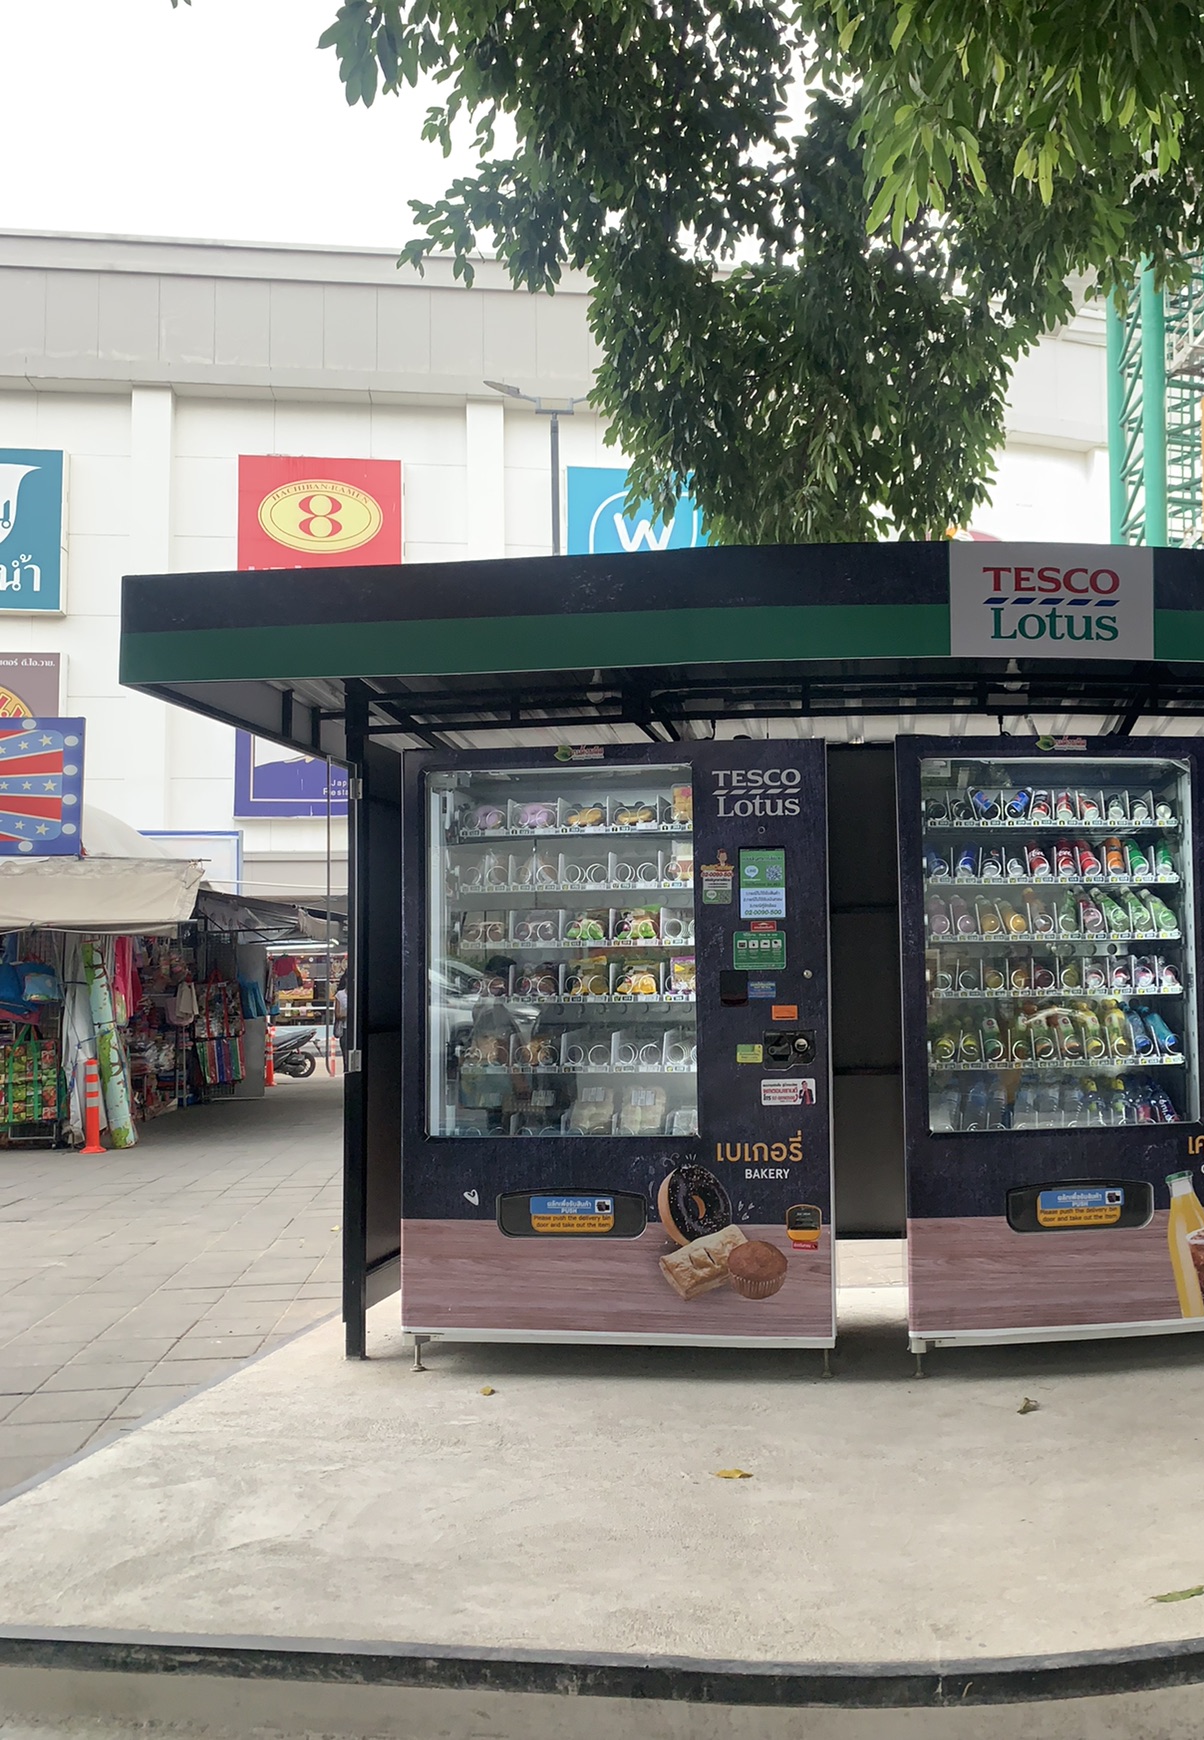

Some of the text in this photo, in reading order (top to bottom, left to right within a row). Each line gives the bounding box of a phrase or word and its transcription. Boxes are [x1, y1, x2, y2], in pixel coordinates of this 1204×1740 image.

[298, 494, 342, 539] 8
[982, 567, 1120, 594] TESCO
[990, 607, 1119, 641] Lotus
[712, 769, 801, 787] TESCO
[717, 795, 800, 817] Lotus
[716, 1130, 803, 1162] เบเกอรี่
[745, 1169, 790, 1179] BAKERY
